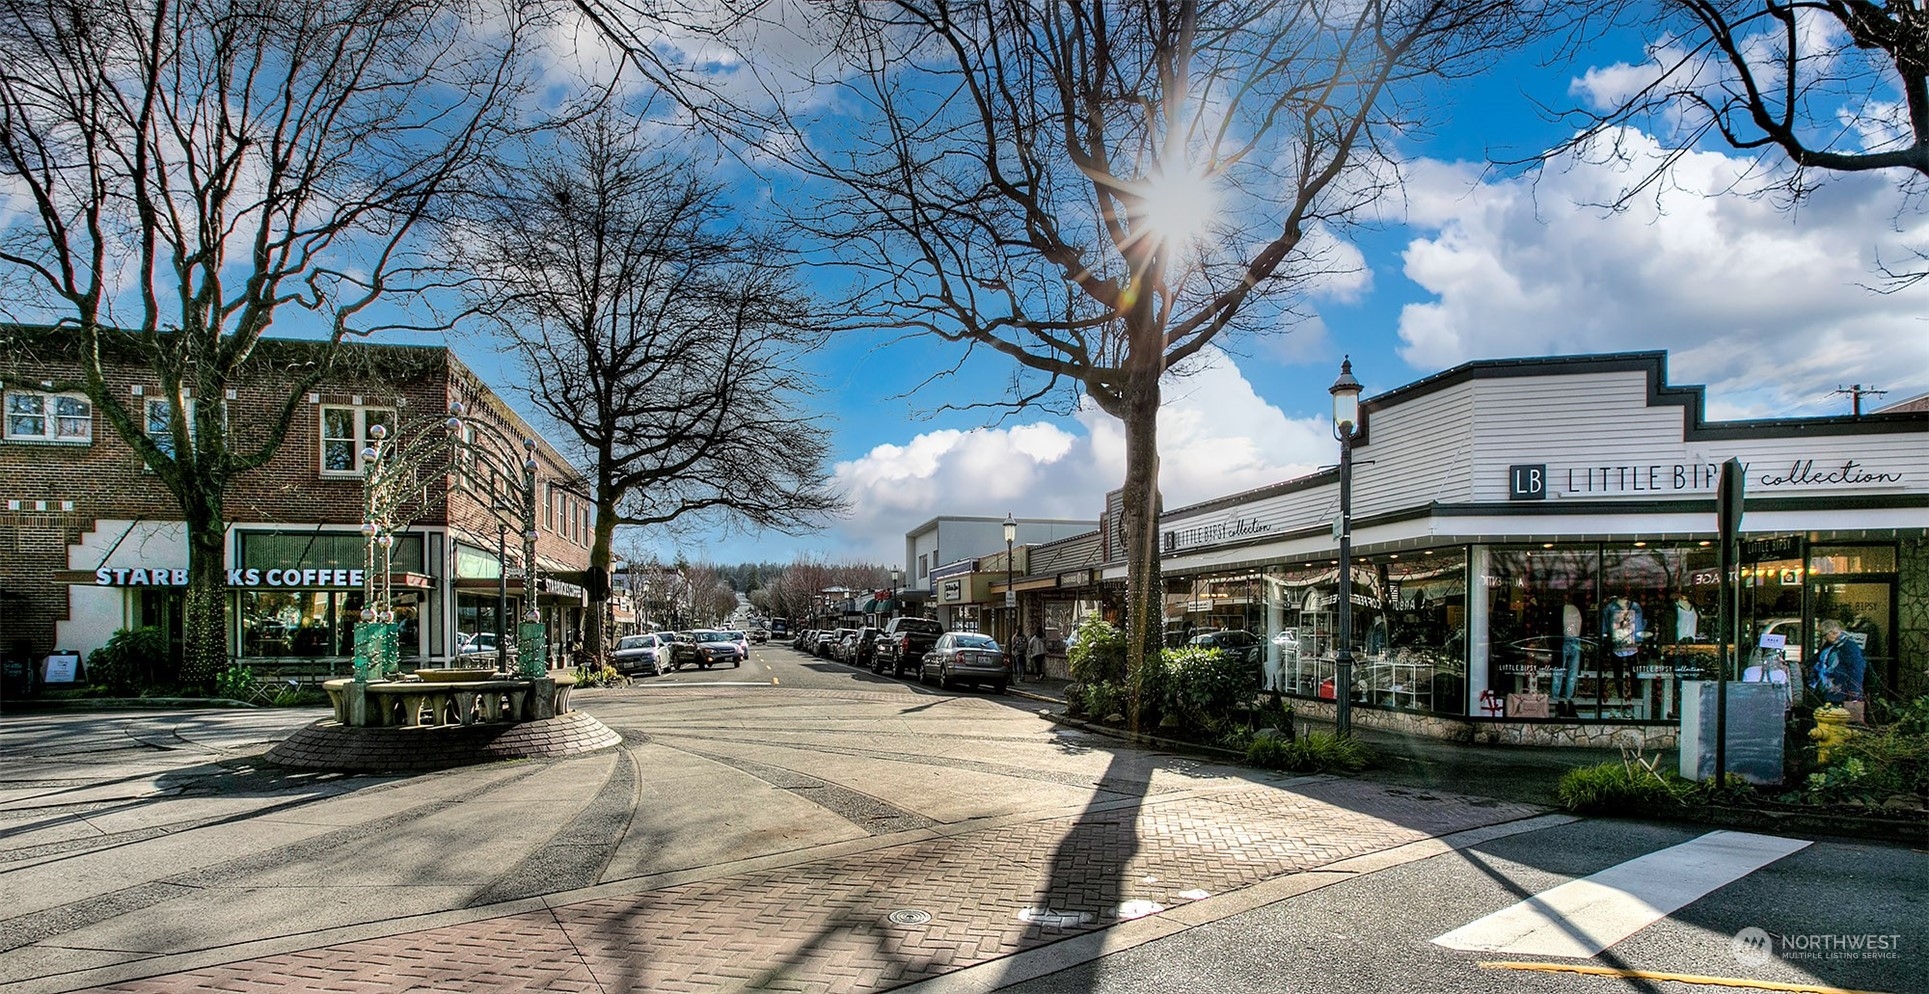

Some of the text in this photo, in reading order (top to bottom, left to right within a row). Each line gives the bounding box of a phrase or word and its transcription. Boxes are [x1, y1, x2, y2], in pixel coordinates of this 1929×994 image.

[1516, 459, 1902, 494] LB LITTLE BIPY collection
[1177, 529, 1203, 547] LITTLE
[1204, 523, 1227, 542] BIPSY
[1228, 518, 1272, 537] collection
[1747, 538, 1791, 554] LITTLE BIPSY
[96, 567, 364, 586] STARBKS COFFEE
[1855, 602, 1878, 611] BIPSY
